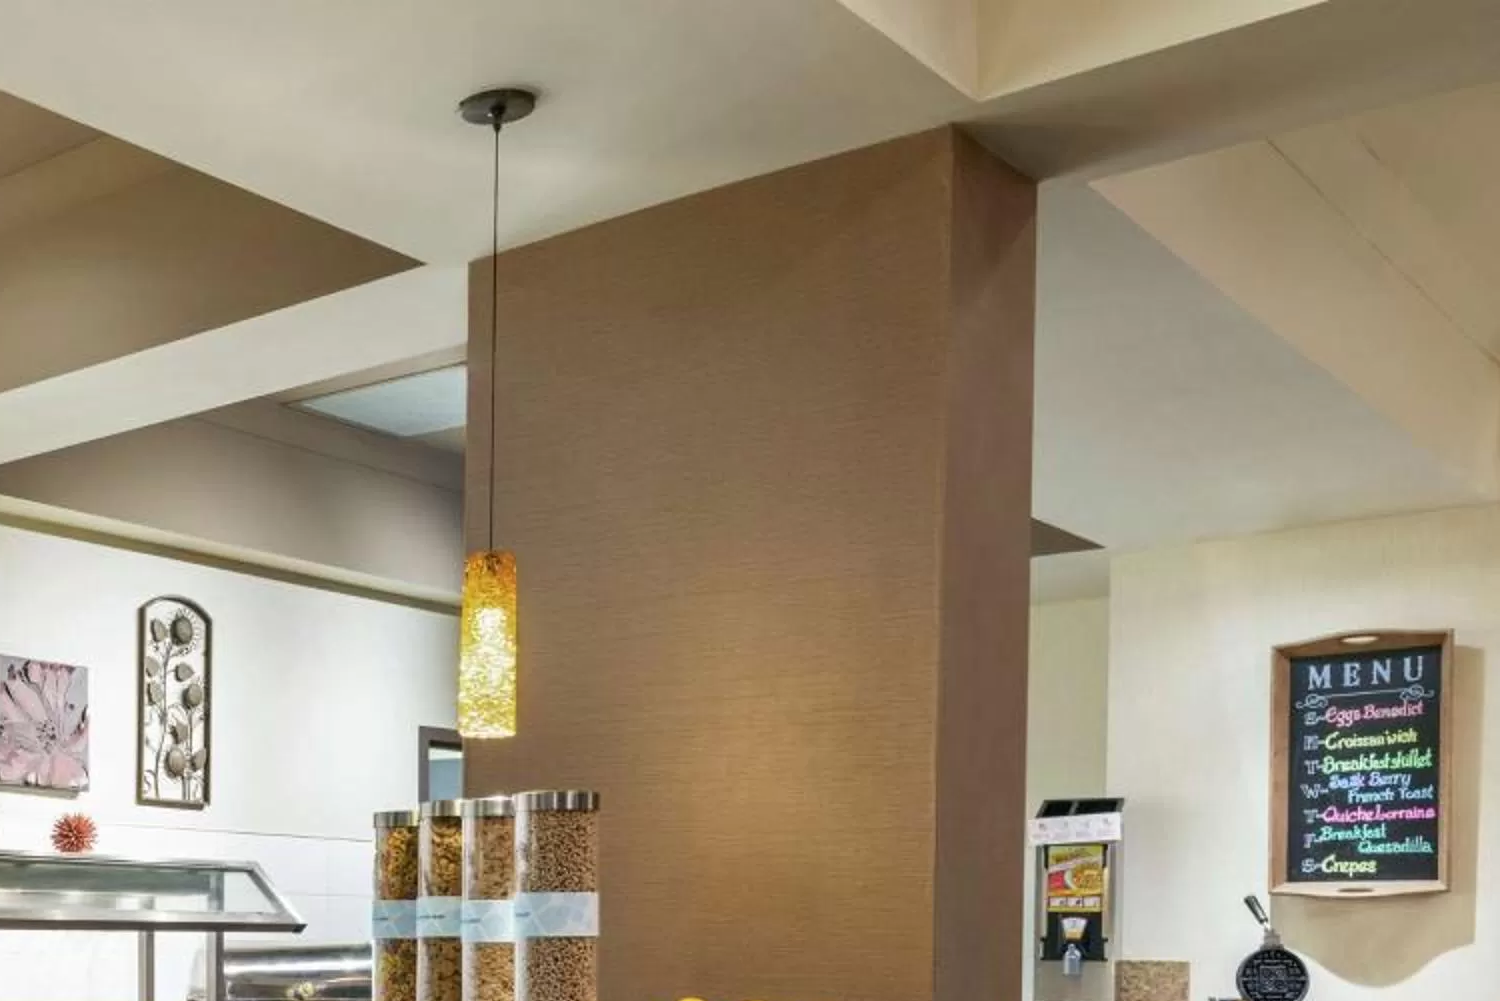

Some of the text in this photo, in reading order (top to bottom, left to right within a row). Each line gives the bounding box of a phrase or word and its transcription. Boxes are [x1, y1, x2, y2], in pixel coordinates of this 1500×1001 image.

[1308, 655, 1424, 691] MENU
[1364, 699, 1424, 720] Benedict
[1347, 784, 1434, 804] French Toast
[1373, 804, 1436, 821] Lorraine
[1358, 835, 1433, 853] Quesadilla
